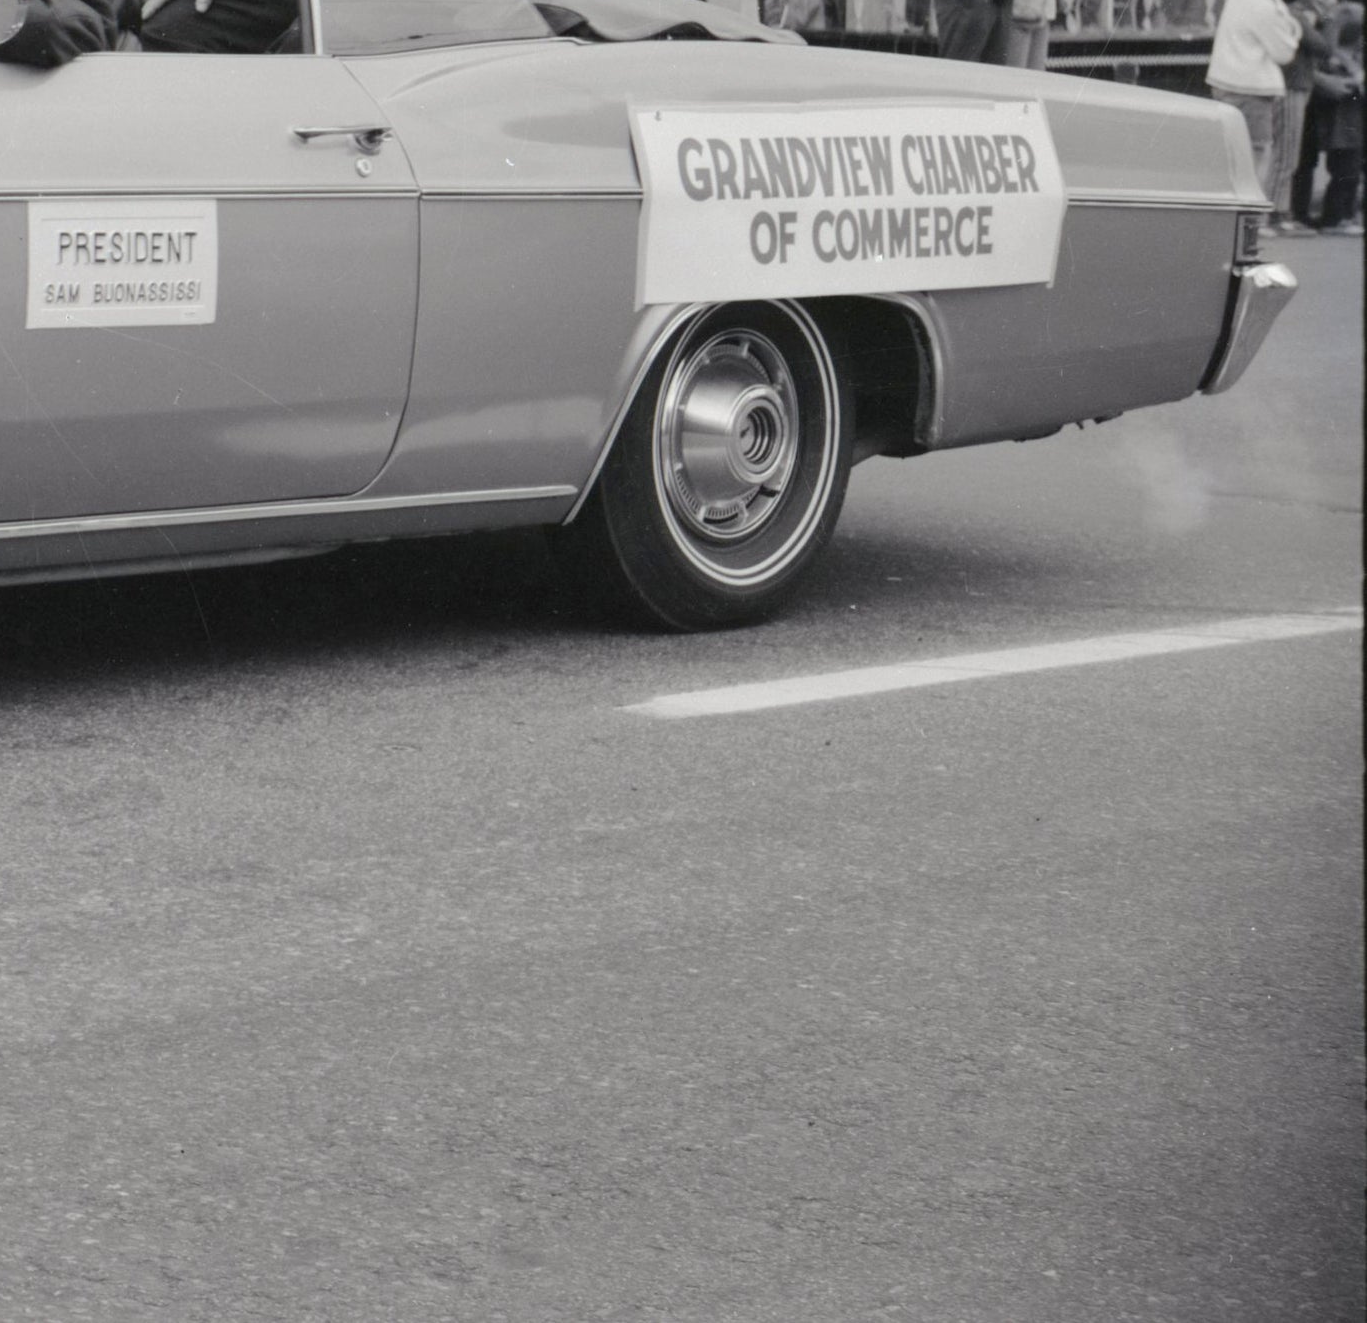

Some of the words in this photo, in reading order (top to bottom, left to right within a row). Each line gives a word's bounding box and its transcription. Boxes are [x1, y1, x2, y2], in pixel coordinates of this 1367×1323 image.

[676, 134, 892, 202] GRANDVIEW
[900, 133, 1041, 197] CHAMBER
[56, 230, 198, 266] PRESIDENT
[748, 209, 798, 265] OF
[811, 204, 994, 263] COMMERCE
[44, 282, 81, 305] SAM
[91, 280, 202, 305] BUONASSISSI
